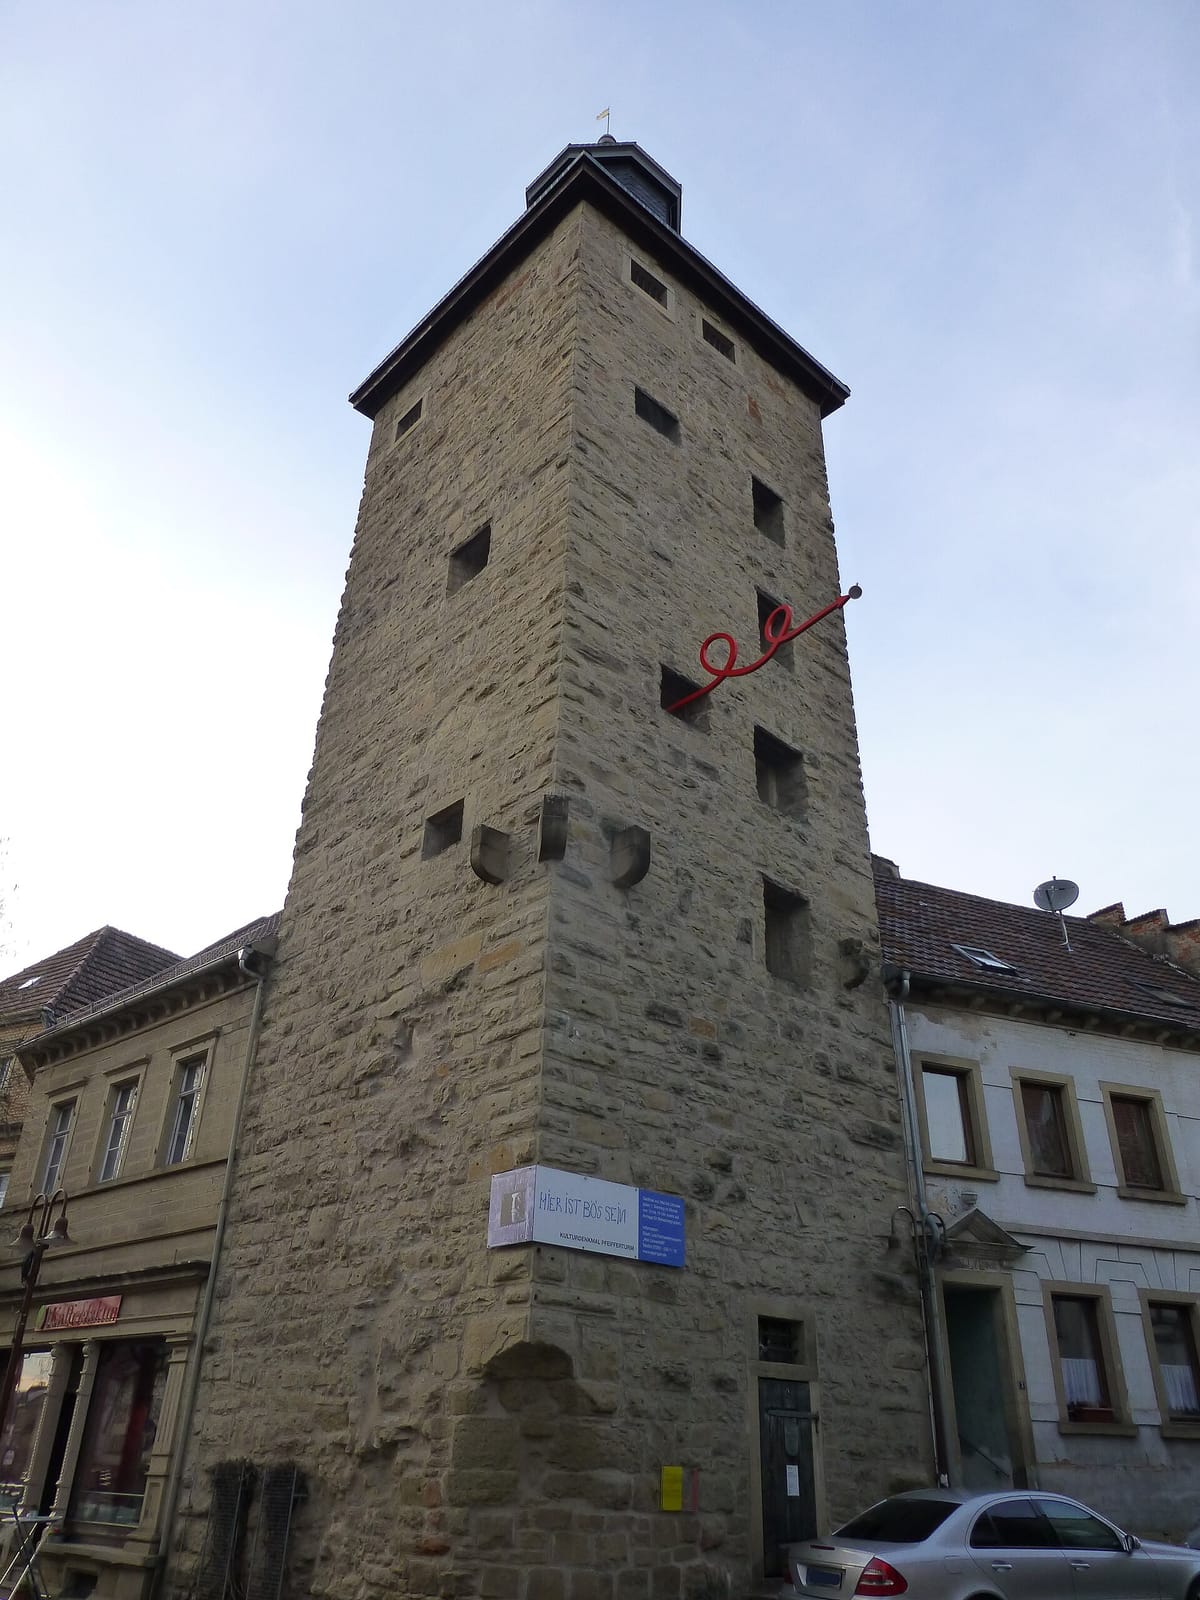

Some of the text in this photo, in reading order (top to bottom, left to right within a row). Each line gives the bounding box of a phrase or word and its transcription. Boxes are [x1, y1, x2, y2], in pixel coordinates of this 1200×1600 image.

[583, 1200, 603, 1219] BÖS
[559, 1231, 601, 1246] KULTURDENKMAL
[601, 1239, 635, 1251] PFEIFFERTURM
